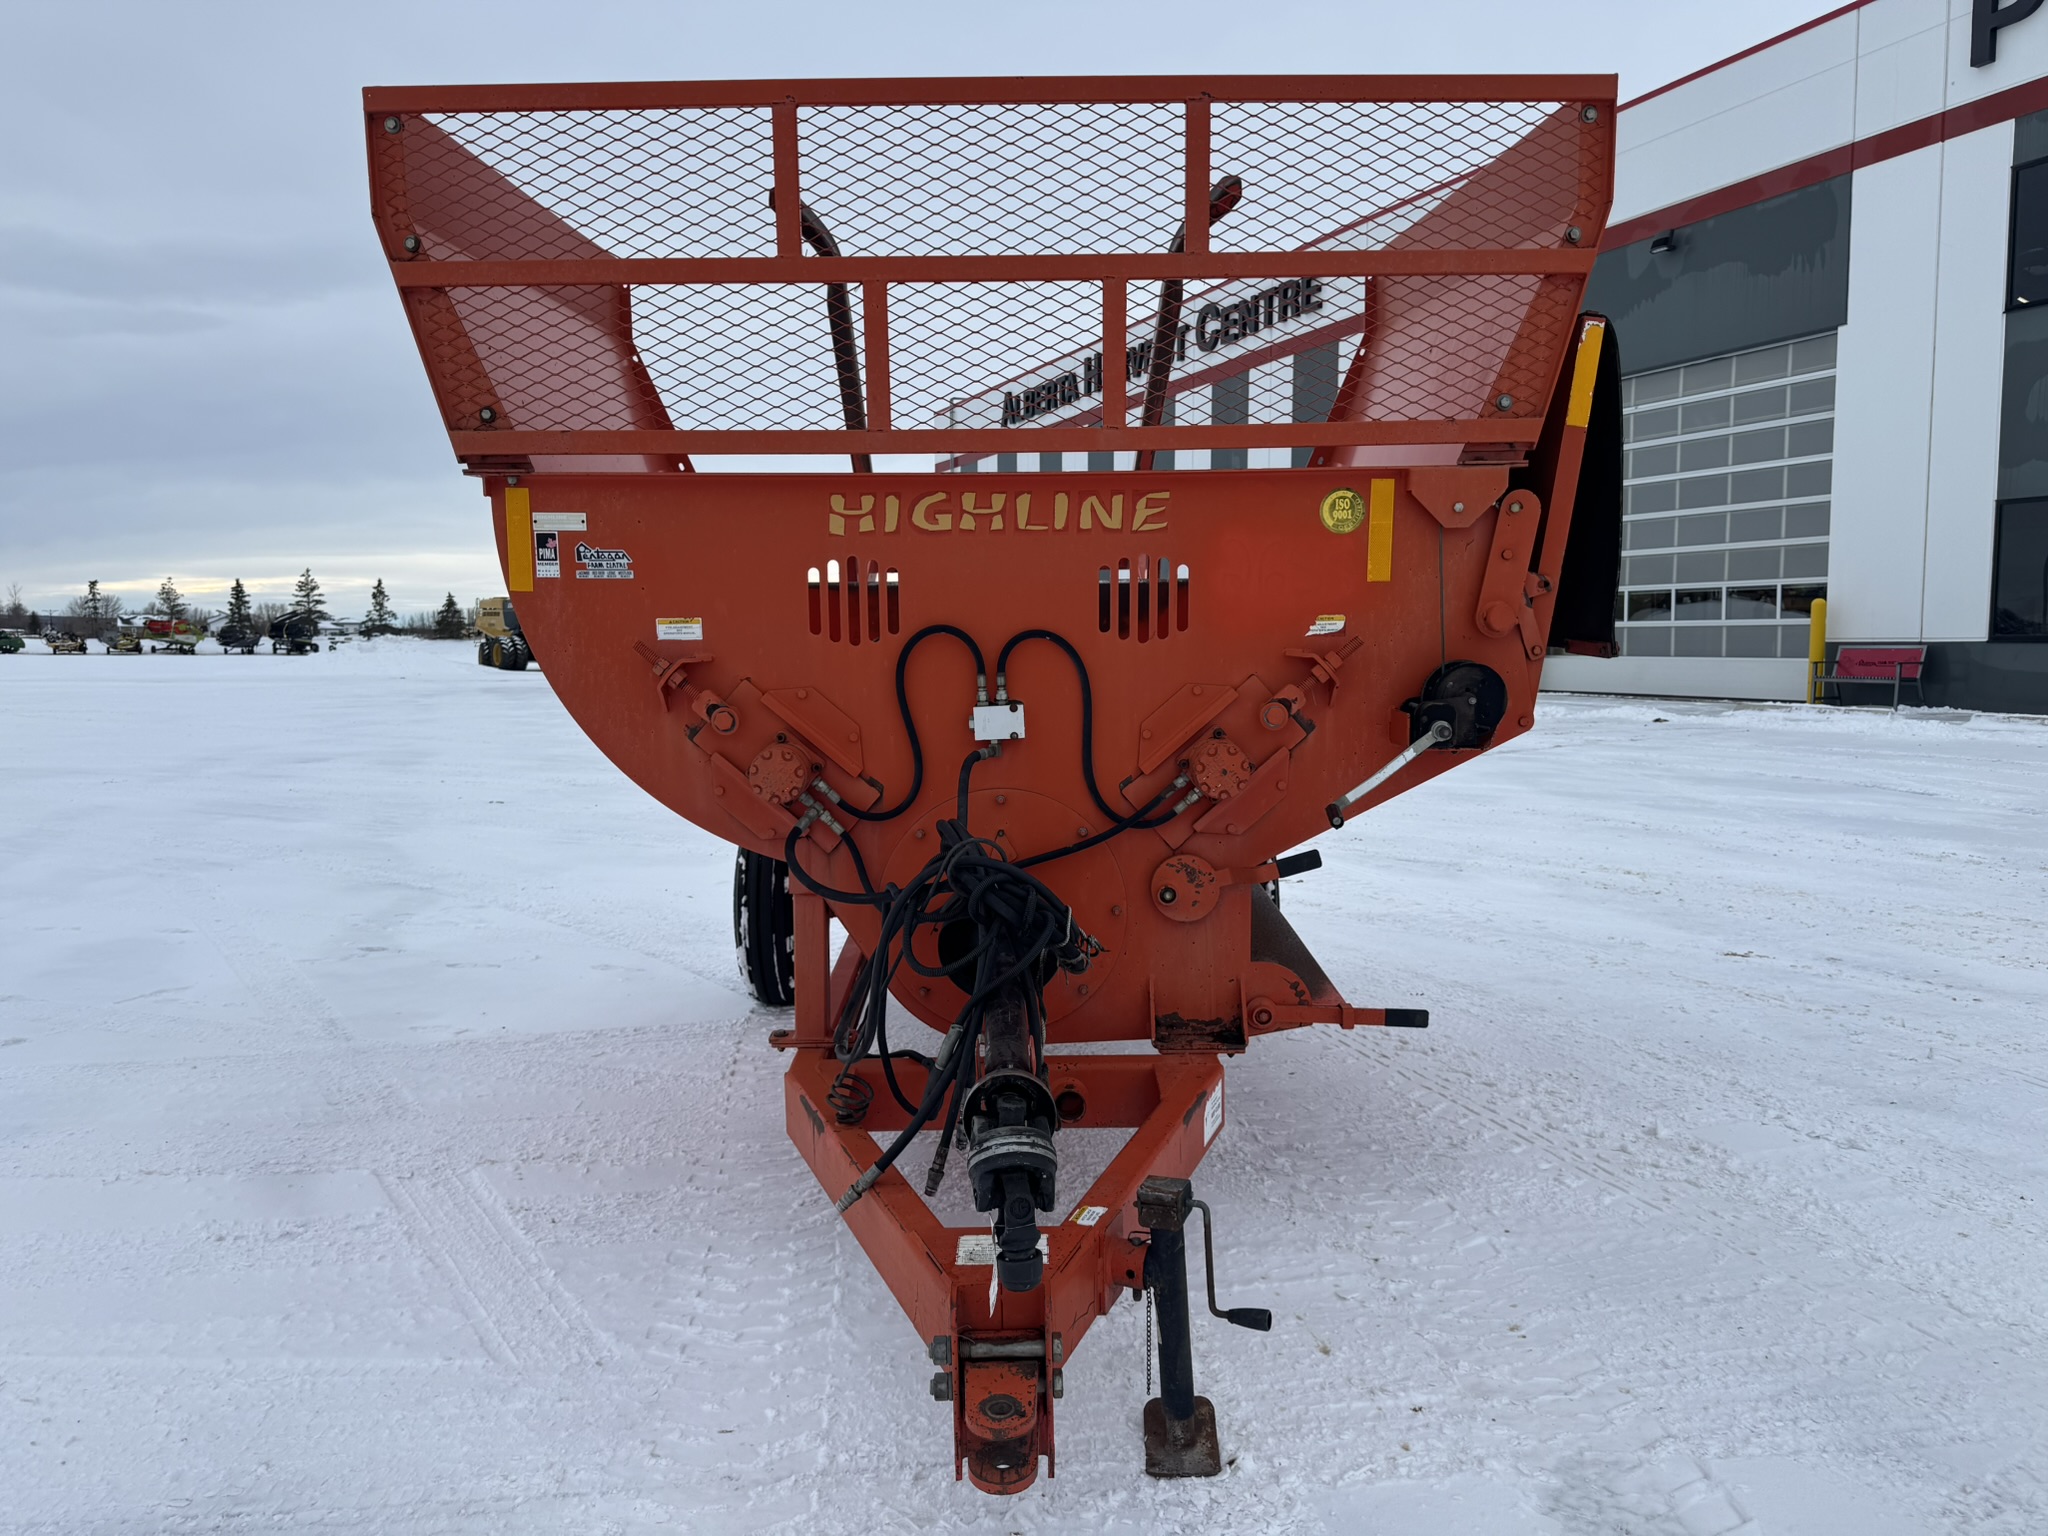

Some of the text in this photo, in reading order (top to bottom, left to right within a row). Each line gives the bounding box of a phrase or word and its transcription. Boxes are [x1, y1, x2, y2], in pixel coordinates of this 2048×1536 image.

[1001, 372, 1080, 427] ALBERTA
[1196, 277, 1322, 352] CENTRE
[1335, 498, 1351, 510] ISO
[829, 491, 1171, 536] HIGHLINE
[1332, 509, 1353, 522] 9001
[538, 547, 556, 560] PIMA
